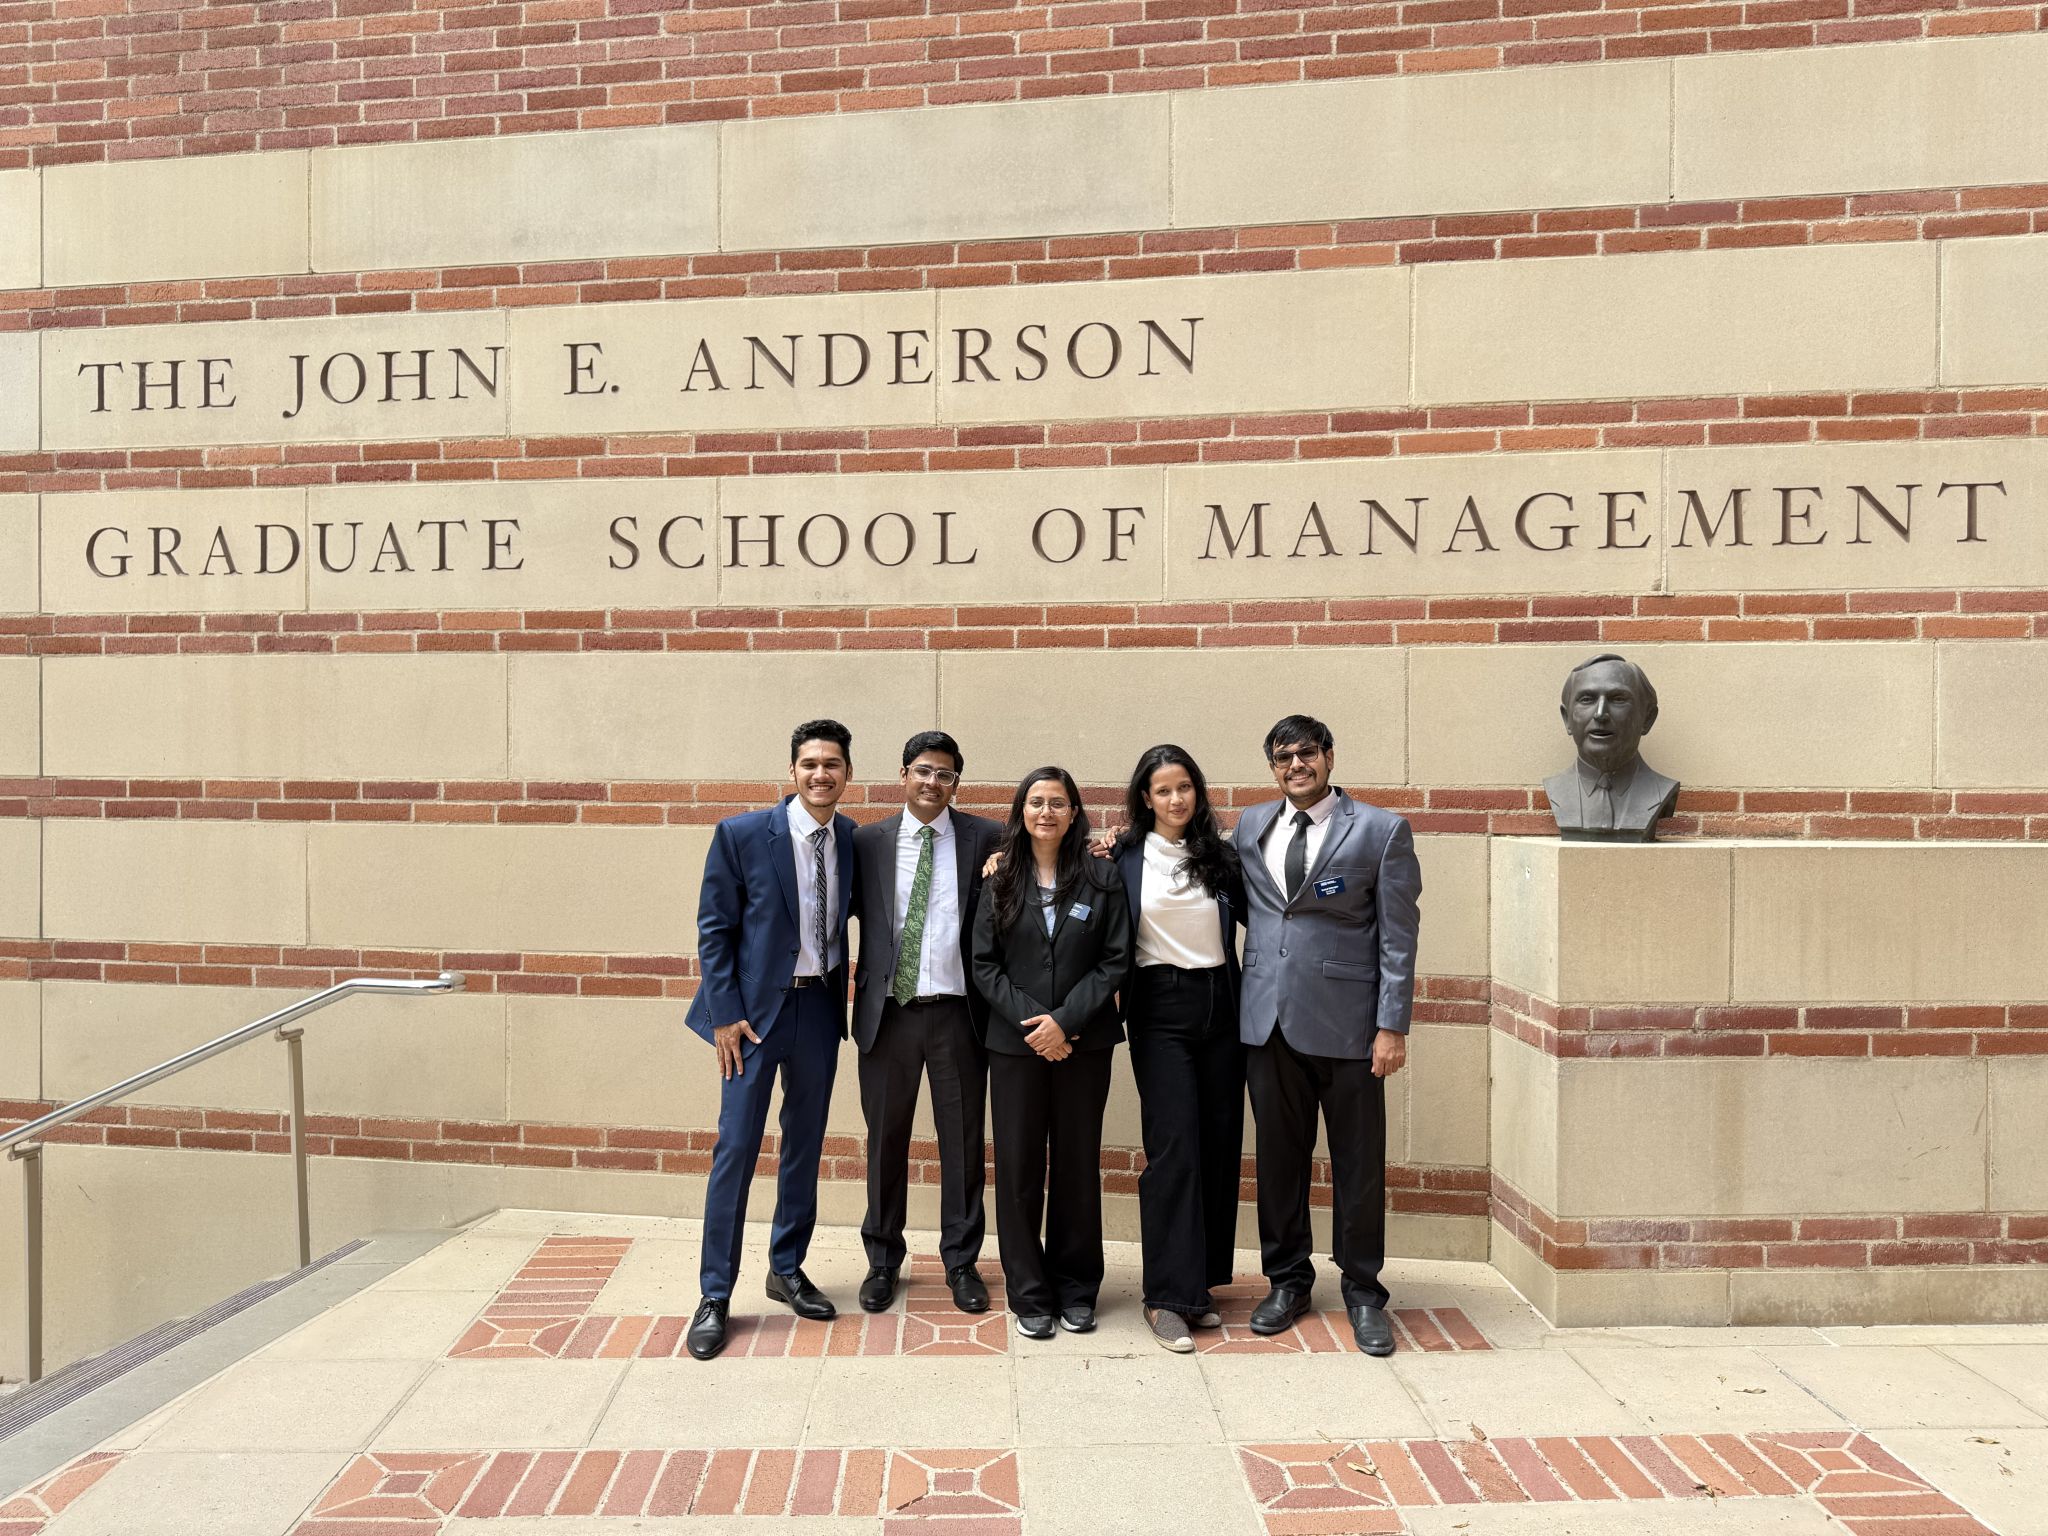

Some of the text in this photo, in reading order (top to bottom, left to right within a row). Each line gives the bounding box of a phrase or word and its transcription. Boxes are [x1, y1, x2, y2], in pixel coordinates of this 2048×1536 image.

[78, 317, 1204, 418] THE JOHN E. ANDERSON
[85, 480, 2008, 579] GRADUATE SCHOOL OF MANAGEMENT
